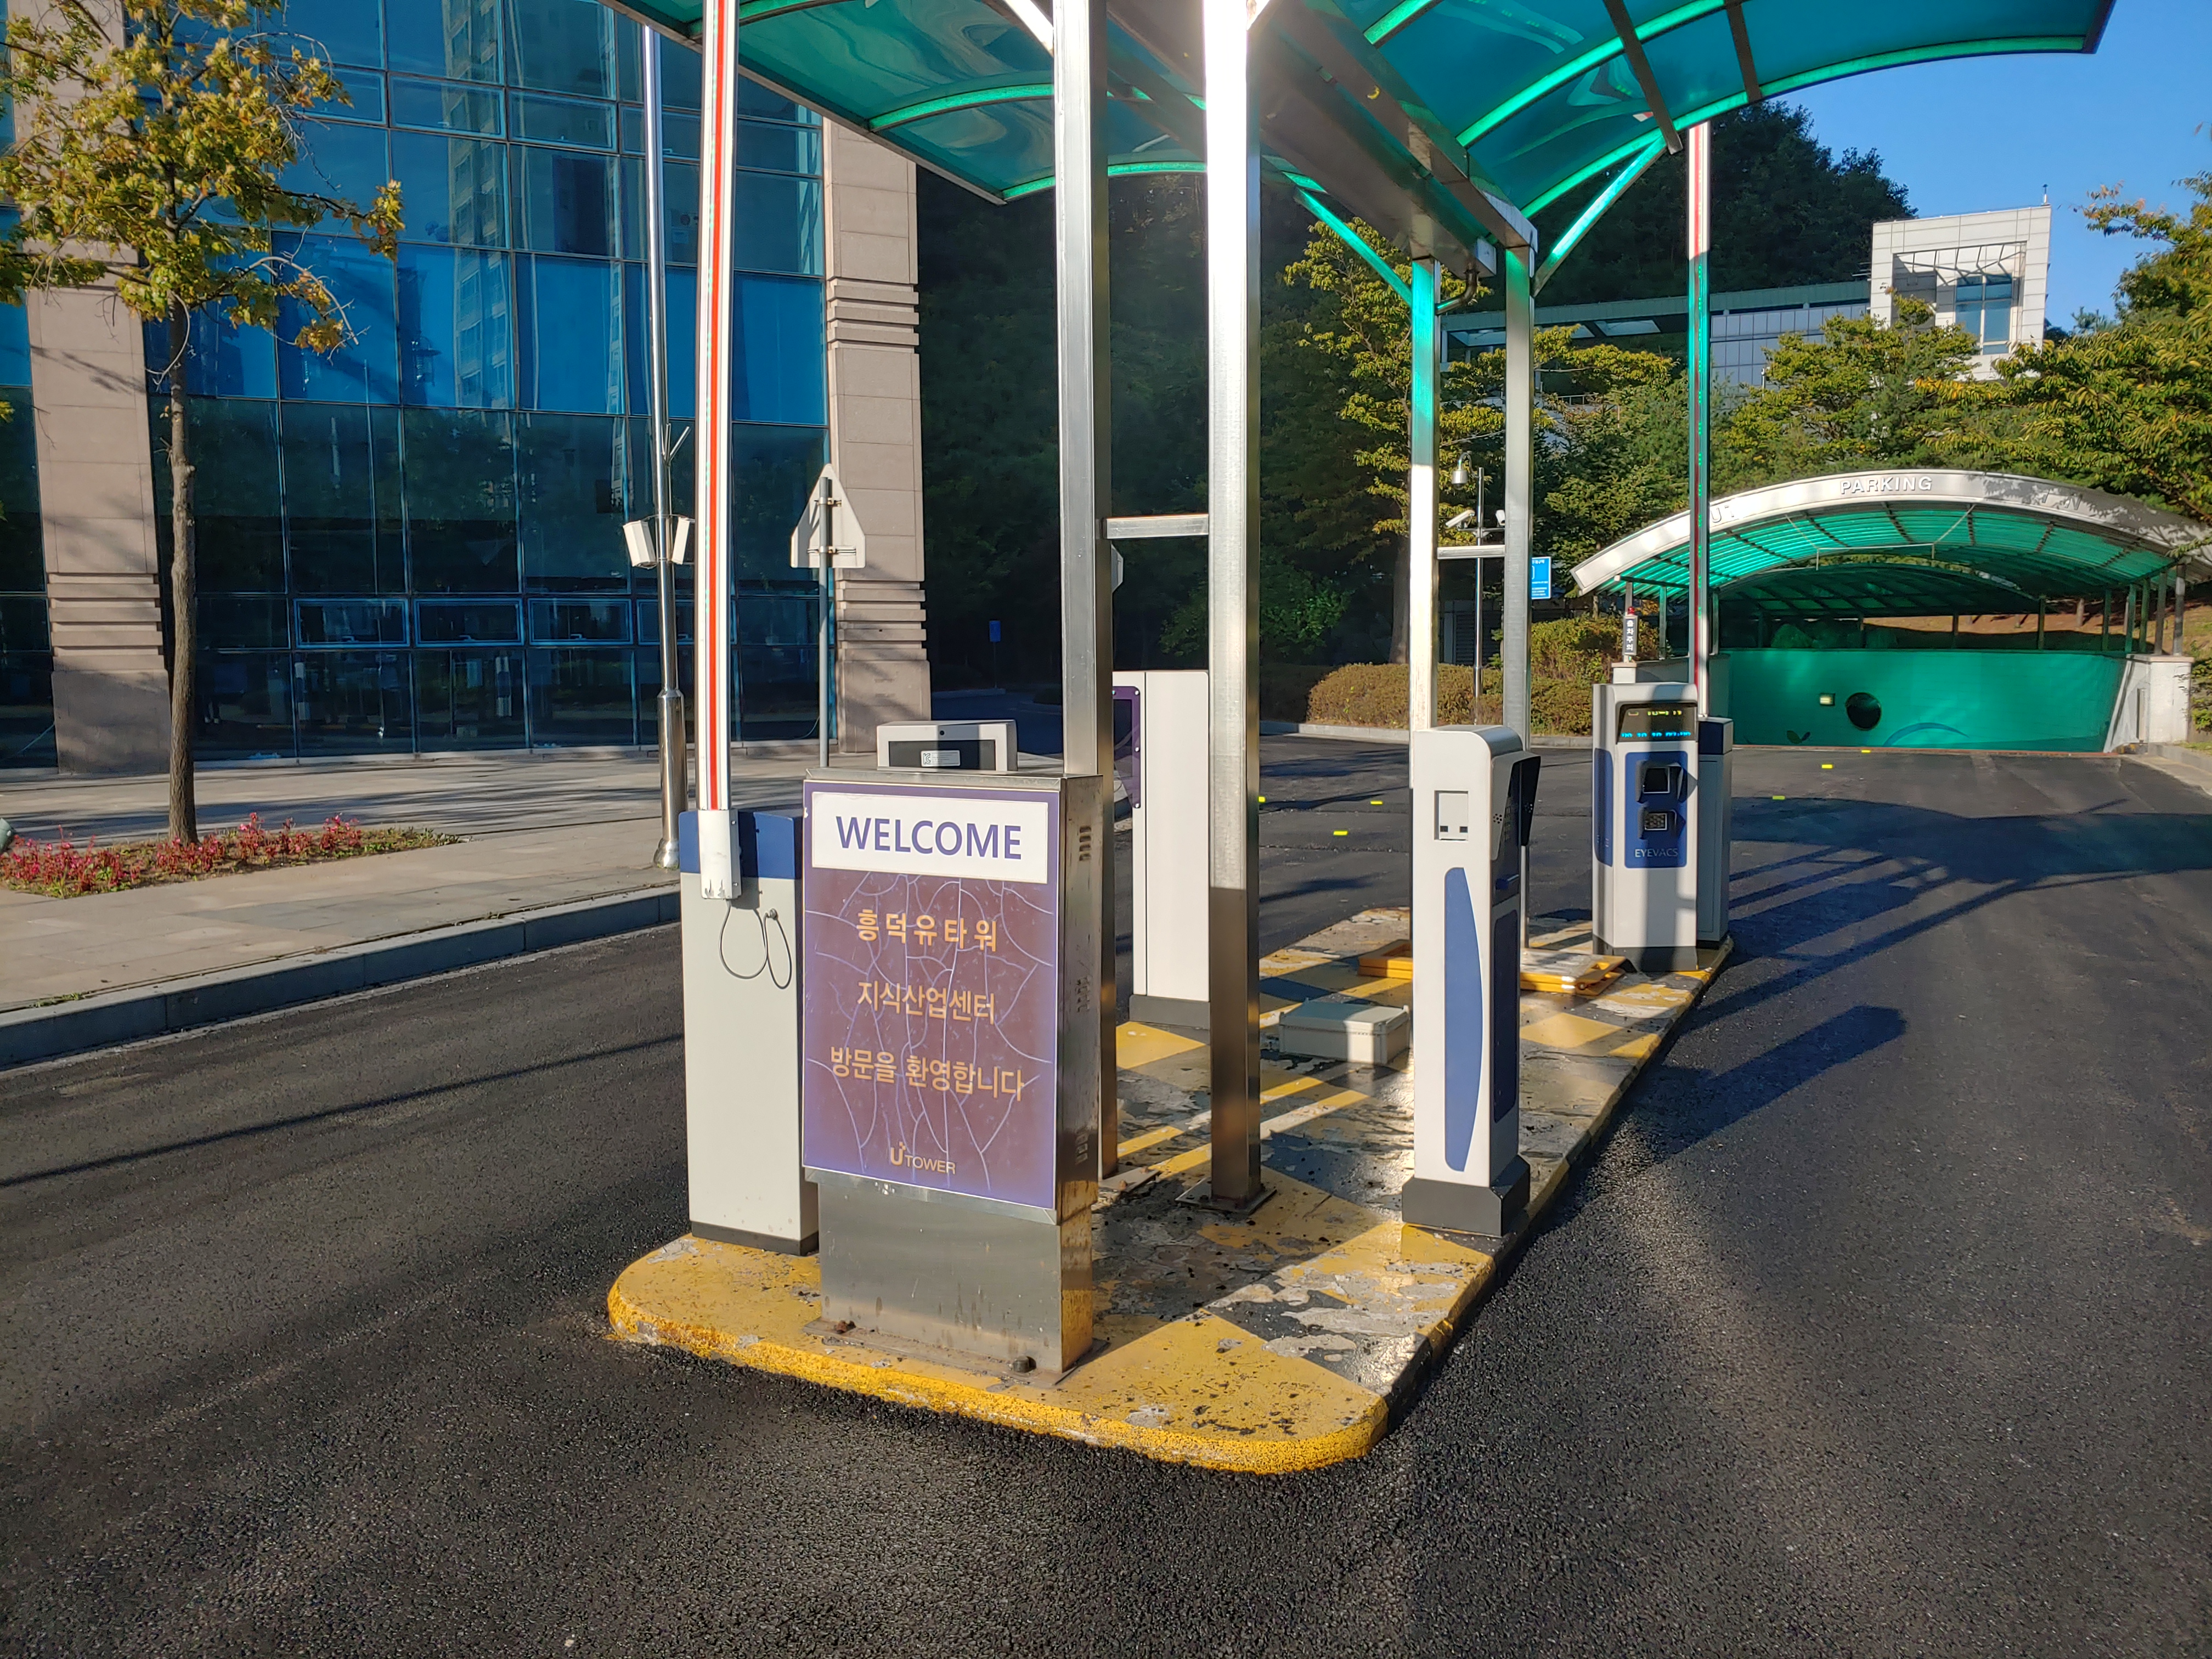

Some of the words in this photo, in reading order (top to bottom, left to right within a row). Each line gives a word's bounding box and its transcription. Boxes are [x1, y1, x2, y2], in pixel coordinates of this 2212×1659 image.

[1840, 476, 1932, 494] PARKING
[1709, 504, 1735, 523] UT
[836, 816, 1022, 860] WELCOME
[1635, 848, 1679, 857] EYEVACS
[856, 909, 996, 952] 흥덕유타워
[857, 980, 995, 1025] 지식산업센터
[831, 1046, 897, 1084] 방문을
[906, 1055, 1025, 1102] 환영합니다
